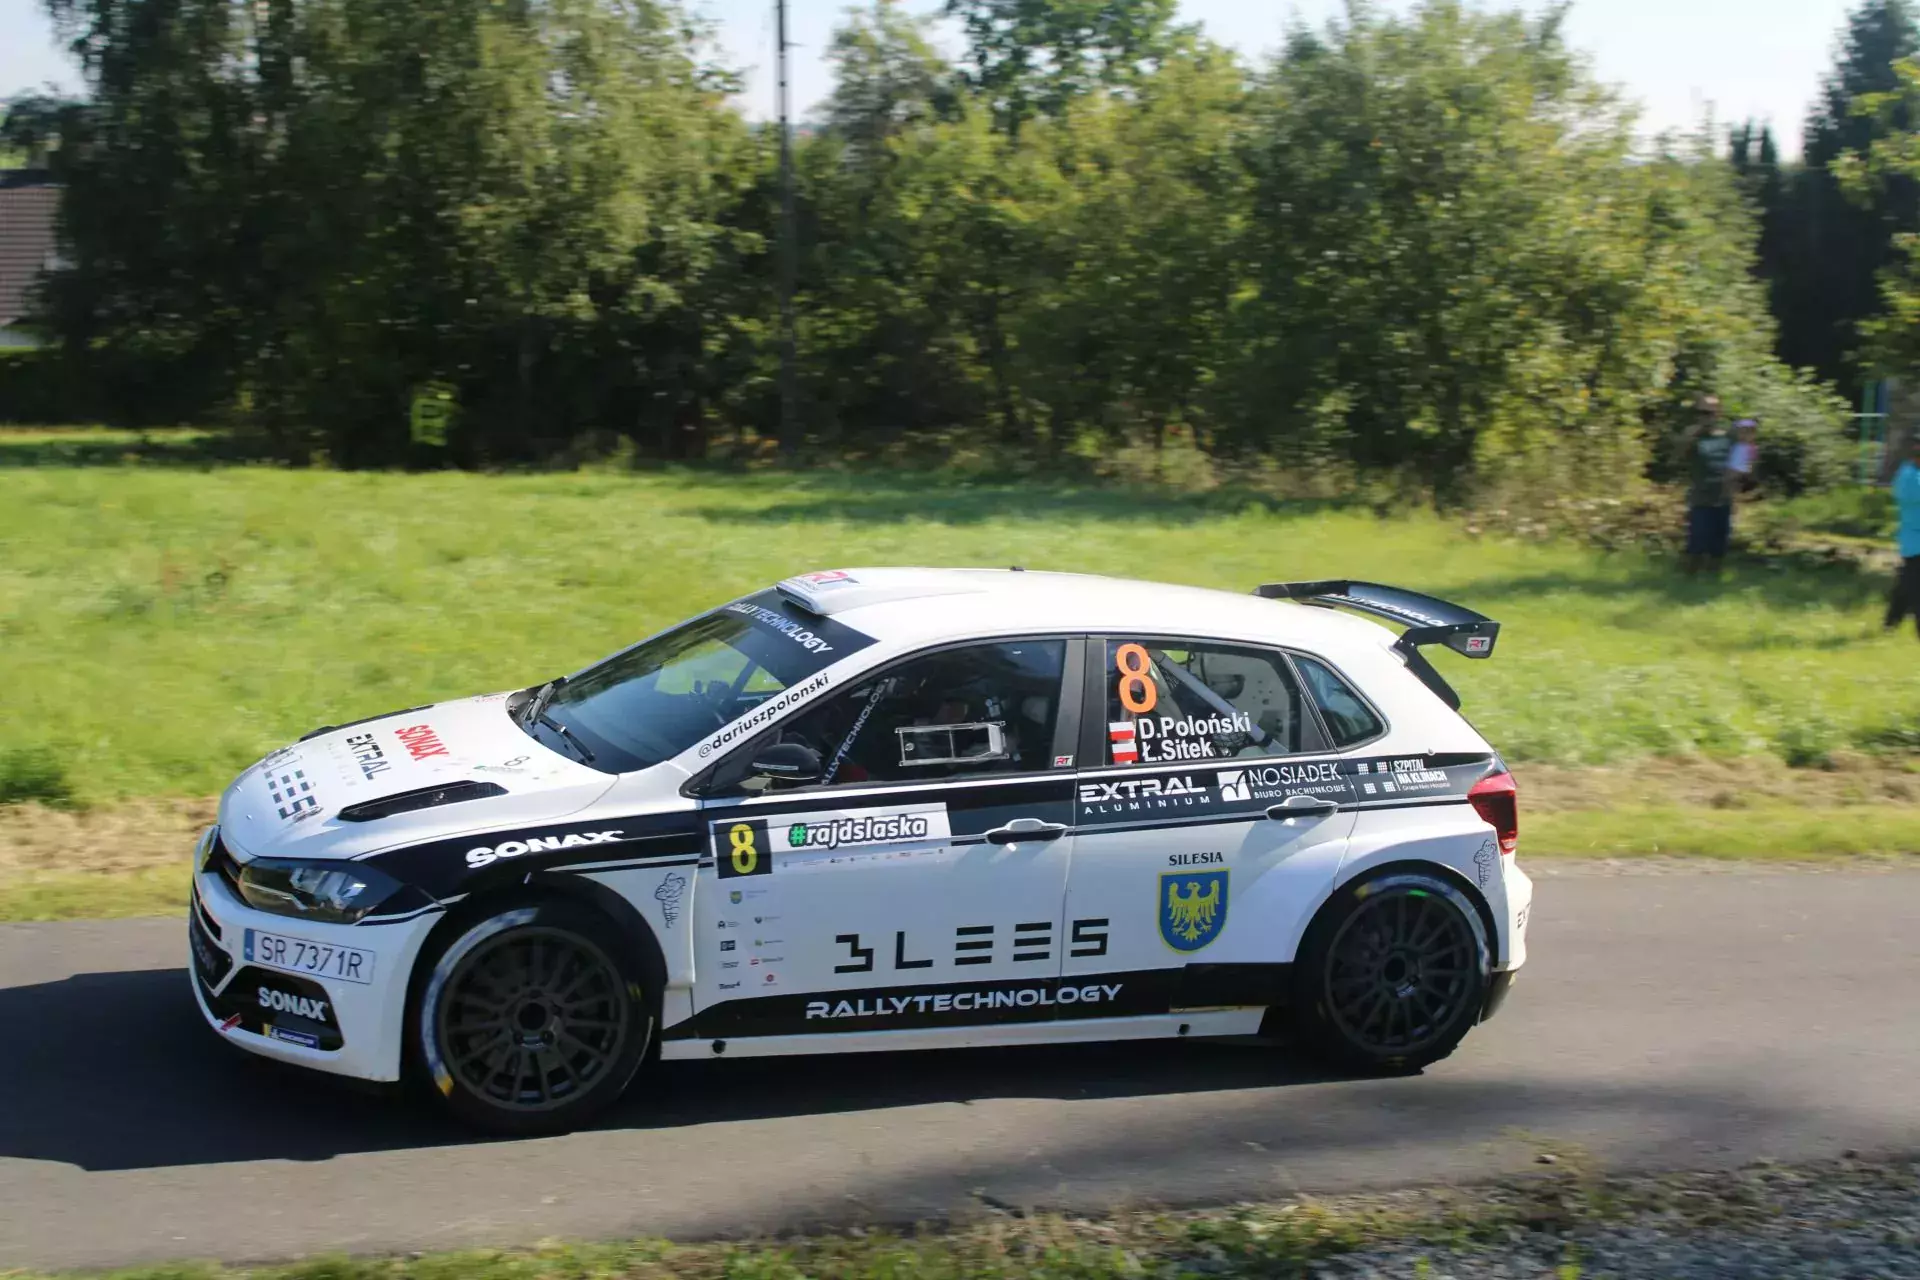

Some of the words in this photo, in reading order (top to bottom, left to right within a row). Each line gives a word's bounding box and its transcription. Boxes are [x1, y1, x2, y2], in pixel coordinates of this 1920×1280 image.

[1468, 637, 1486, 649] RT
[1116, 643, 1157, 714] 8
[698, 672, 830, 758] @dariuszpolonski
[1138, 711, 1251, 740] D.Poloński
[346, 733, 391, 780] EXTRAL
[394, 724, 449, 761] SONAX
[1142, 737, 1215, 763] Ł.Sitek
[1249, 762, 1342, 787] NOSIADEK
[1394, 758, 1426, 772] SZPITAL
[1397, 772, 1412, 784] NA
[1079, 776, 1206, 803] EXTRAL
[1084, 795, 1210, 814] ALUMINIUM
[1254, 789, 1282, 799] BIURO
[1286, 784, 1347, 797] RACHUNKOWE
[788, 814, 927, 849] #rajdslaska
[465, 830, 624, 868] SONAX
[729, 823, 757, 874] 8
[1168, 851, 1224, 866] SILESIA
[261, 936, 287, 964] SR
[293, 942, 363, 979] 7371R
[258, 986, 327, 1022] SONAX
[805, 982, 1123, 1020] RALLYTECHNOLOGY
